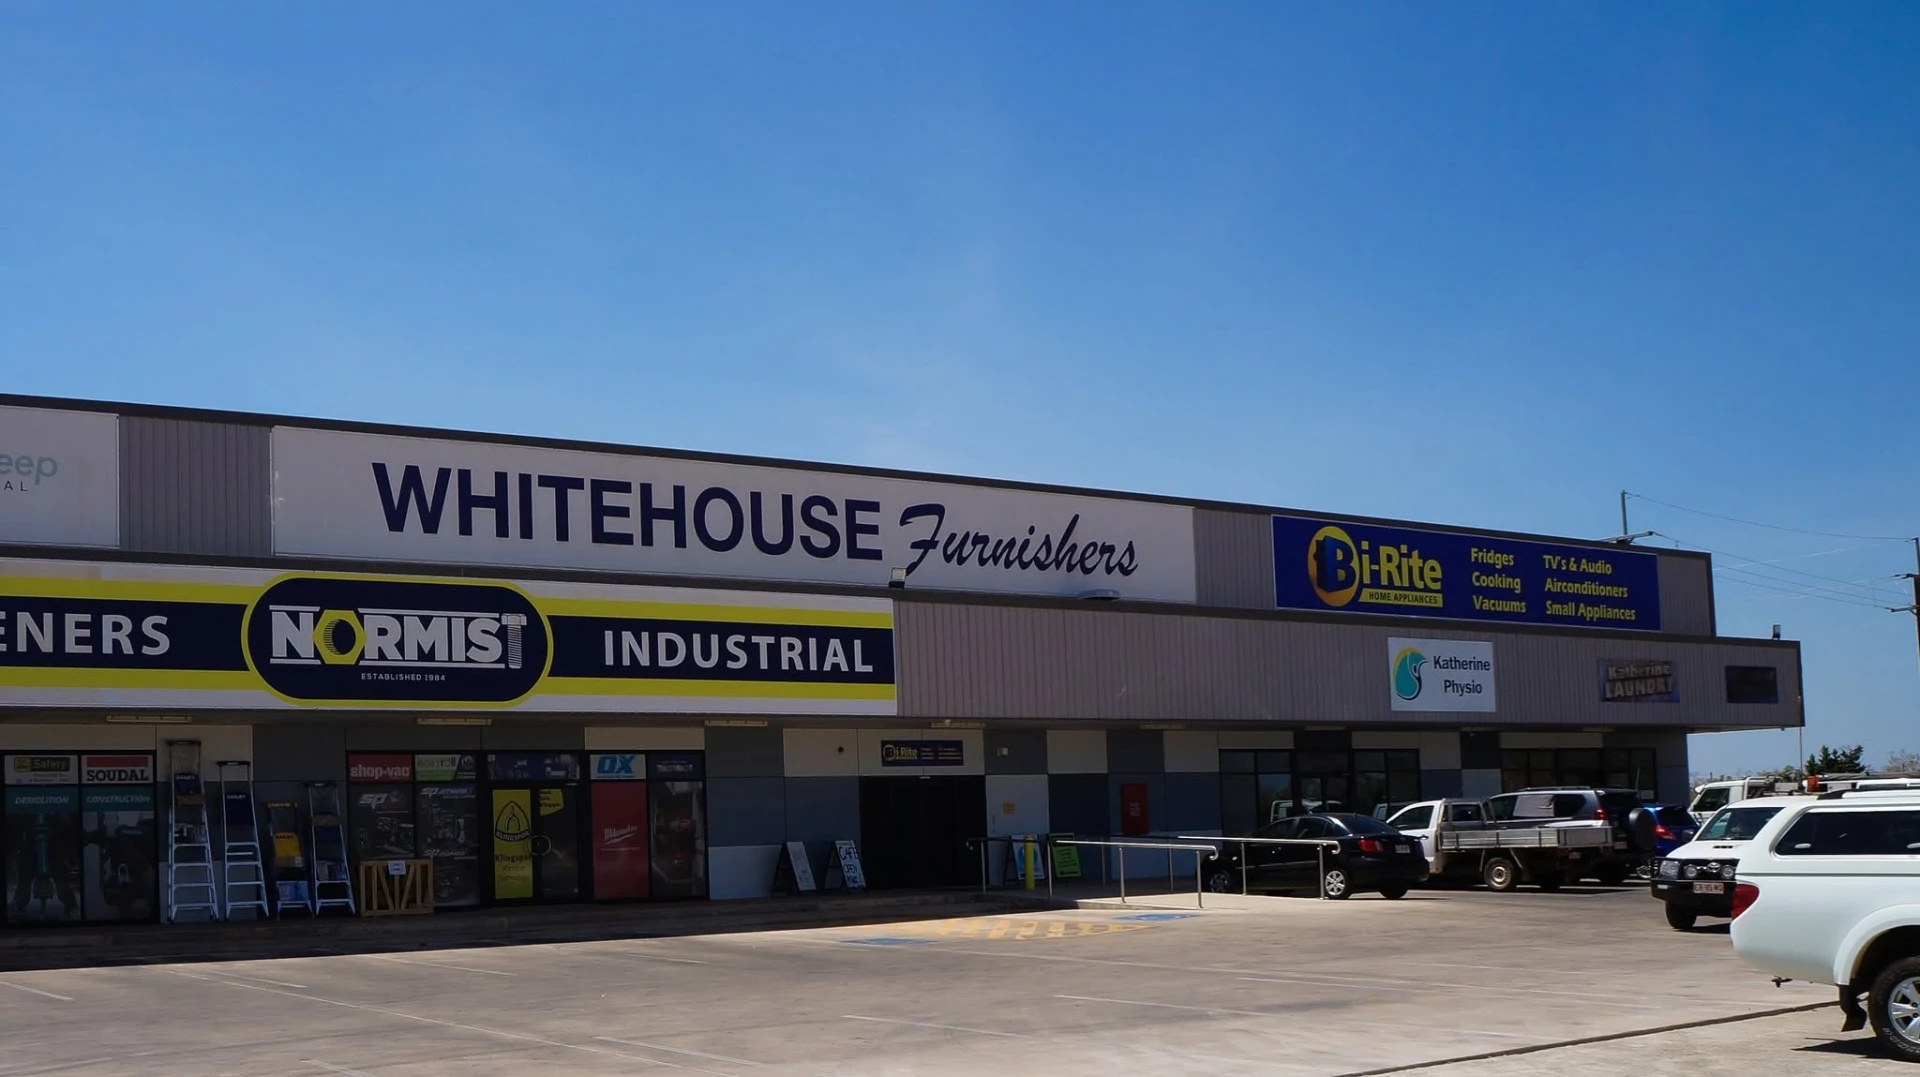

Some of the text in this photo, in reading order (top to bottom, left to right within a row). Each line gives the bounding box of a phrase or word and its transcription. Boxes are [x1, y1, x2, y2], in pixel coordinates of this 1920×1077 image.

[372, 462, 1139, 577] WHITEHOUSE Furnishers
[1314, 534, 1443, 594] Bi-Rite
[1470, 548, 1515, 568] Fridges
[1543, 555, 1613, 575] TV's & Audio
[1472, 571, 1522, 594] Cooking
[1545, 578, 1629, 598] Airconditioners
[1368, 590, 1438, 605] HOME APPLIANCES
[1473, 595, 1527, 613] Vacuums
[1546, 600, 1636, 621] Small Appliances
[0, 611, 171, 656] NERS
[604, 629, 874, 673] INDUSTRIAL
[1433, 654, 1491, 672] Katherine
[1608, 663, 1671, 680] Katherine
[361, 673, 446, 682] ESTABLISHED 1984
[1443, 679, 1483, 696] Physio
[1605, 677, 1673, 699] LAUNDRY
[597, 755, 636, 774] OX
[87, 769, 149, 782] SOUDAL
[14, 796, 70, 805] DEMOLITION
[86, 794, 151, 804] CONSTRUCTION
